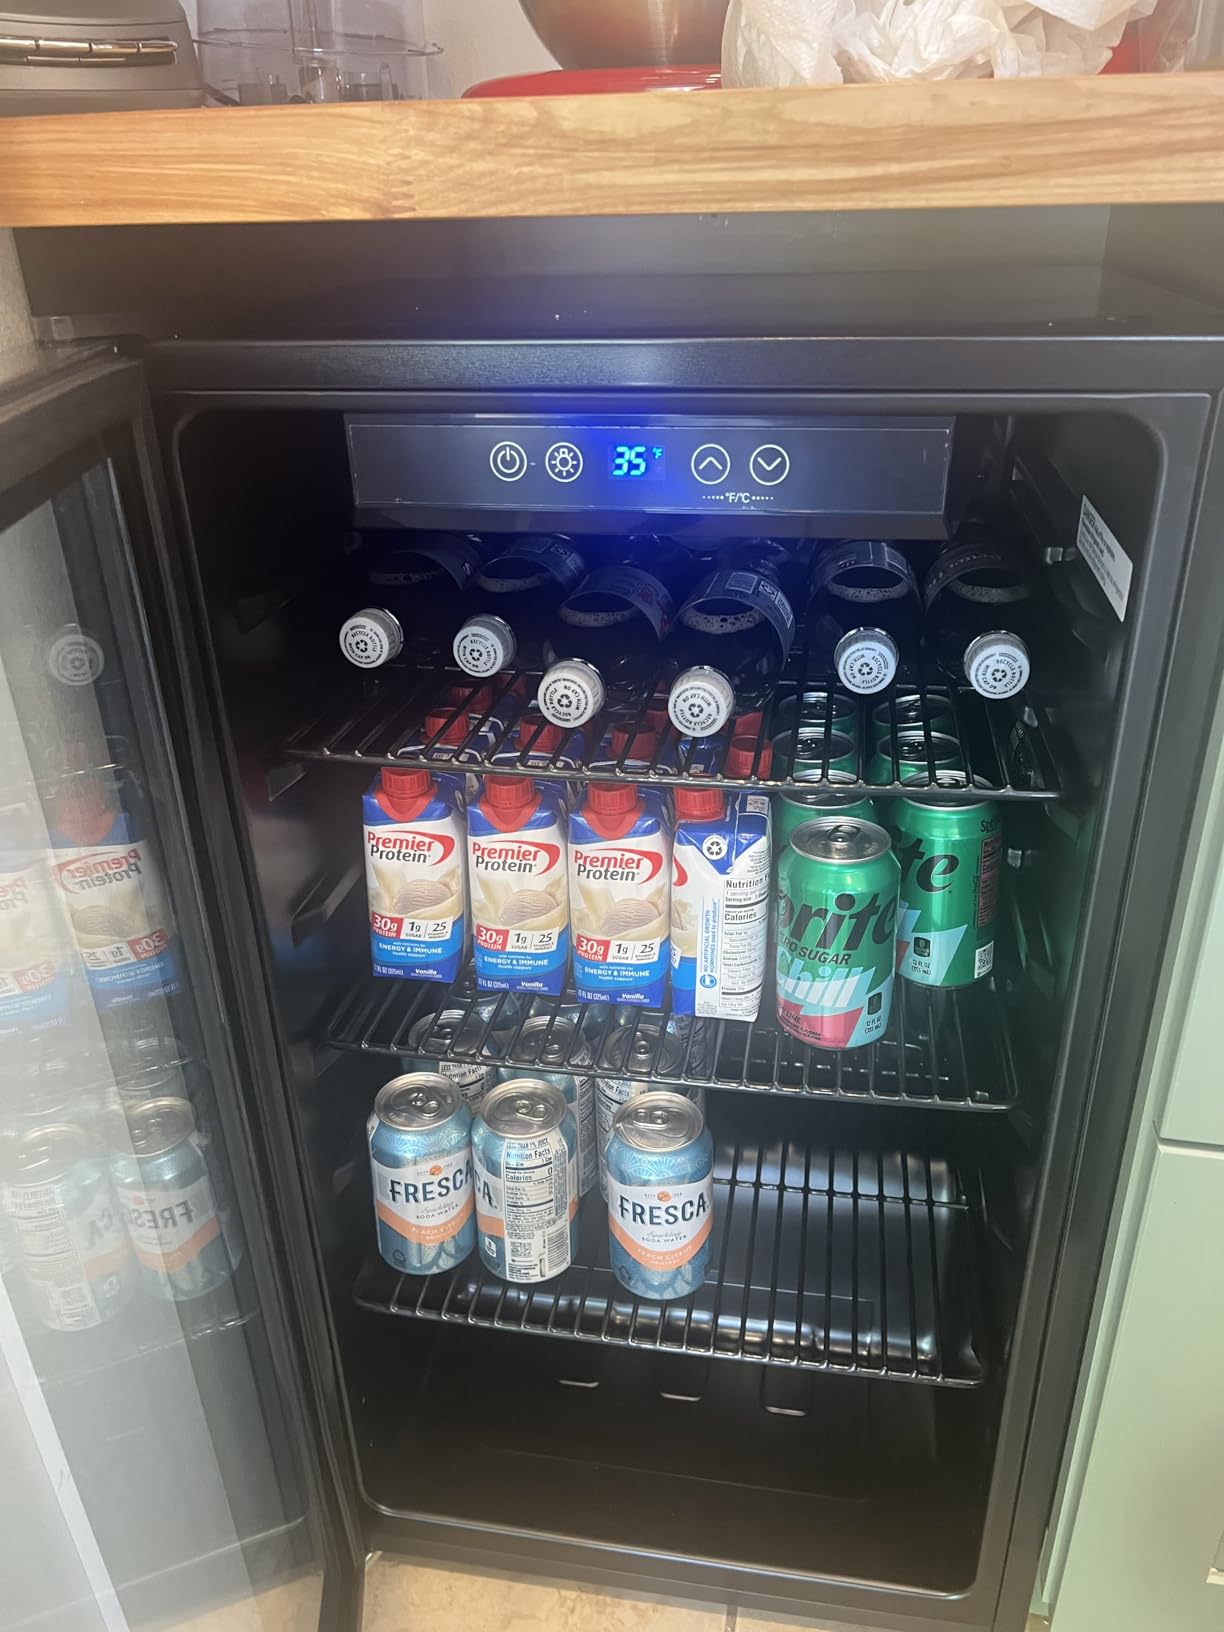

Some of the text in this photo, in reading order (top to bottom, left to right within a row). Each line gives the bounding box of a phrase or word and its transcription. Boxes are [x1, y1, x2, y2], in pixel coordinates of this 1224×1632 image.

[612, 446, 647, 476] 35
[871, 655, 882, 675] RECYCLE
[996, 659, 1016, 671] RECYCLE
[551, 706, 571, 717] RECYCLE
[694, 713, 712, 726] RECYCLE
[367, 831, 435, 852] Premier
[370, 846, 428, 864] Protein
[472, 841, 541, 862] Premier
[475, 855, 533, 874] Protein
[574, 850, 644, 870] Premier
[577, 862, 636, 882] Protein
[725, 876, 763, 889] Nutrition
[724, 911, 757, 921] Calories
[373, 914, 398, 932] 30g
[408, 921, 421, 932] 1g
[432, 922, 447, 932] 25
[372, 926, 397, 937] PROTEIN
[478, 927, 503, 944] 30g
[514, 932, 527, 944] 1g
[537, 932, 553, 943] 25
[379, 942, 405, 951] ENERGY
[477, 940, 502, 950] PROTEIN
[578, 937, 605, 955] 30g
[615, 943, 629, 954] 1g
[639, 942, 655, 953] 25
[778, 934, 852, 966] ERO SUGAR
[484, 956, 512, 965] ENERGY
[577, 950, 603, 961] PROTEIN
[584, 966, 612, 976] ENERGY
[615, 1085, 630, 1097] Facts
[506, 1147, 551, 1160] Nutrition Facts
[505, 1166, 553, 1181] Calories 0
[389, 1159, 473, 1204] FRESCA
[437, 1203, 459, 1216] WATER
[618, 1191, 707, 1226] FRESCA
[663, 1234, 687, 1243] WATER
